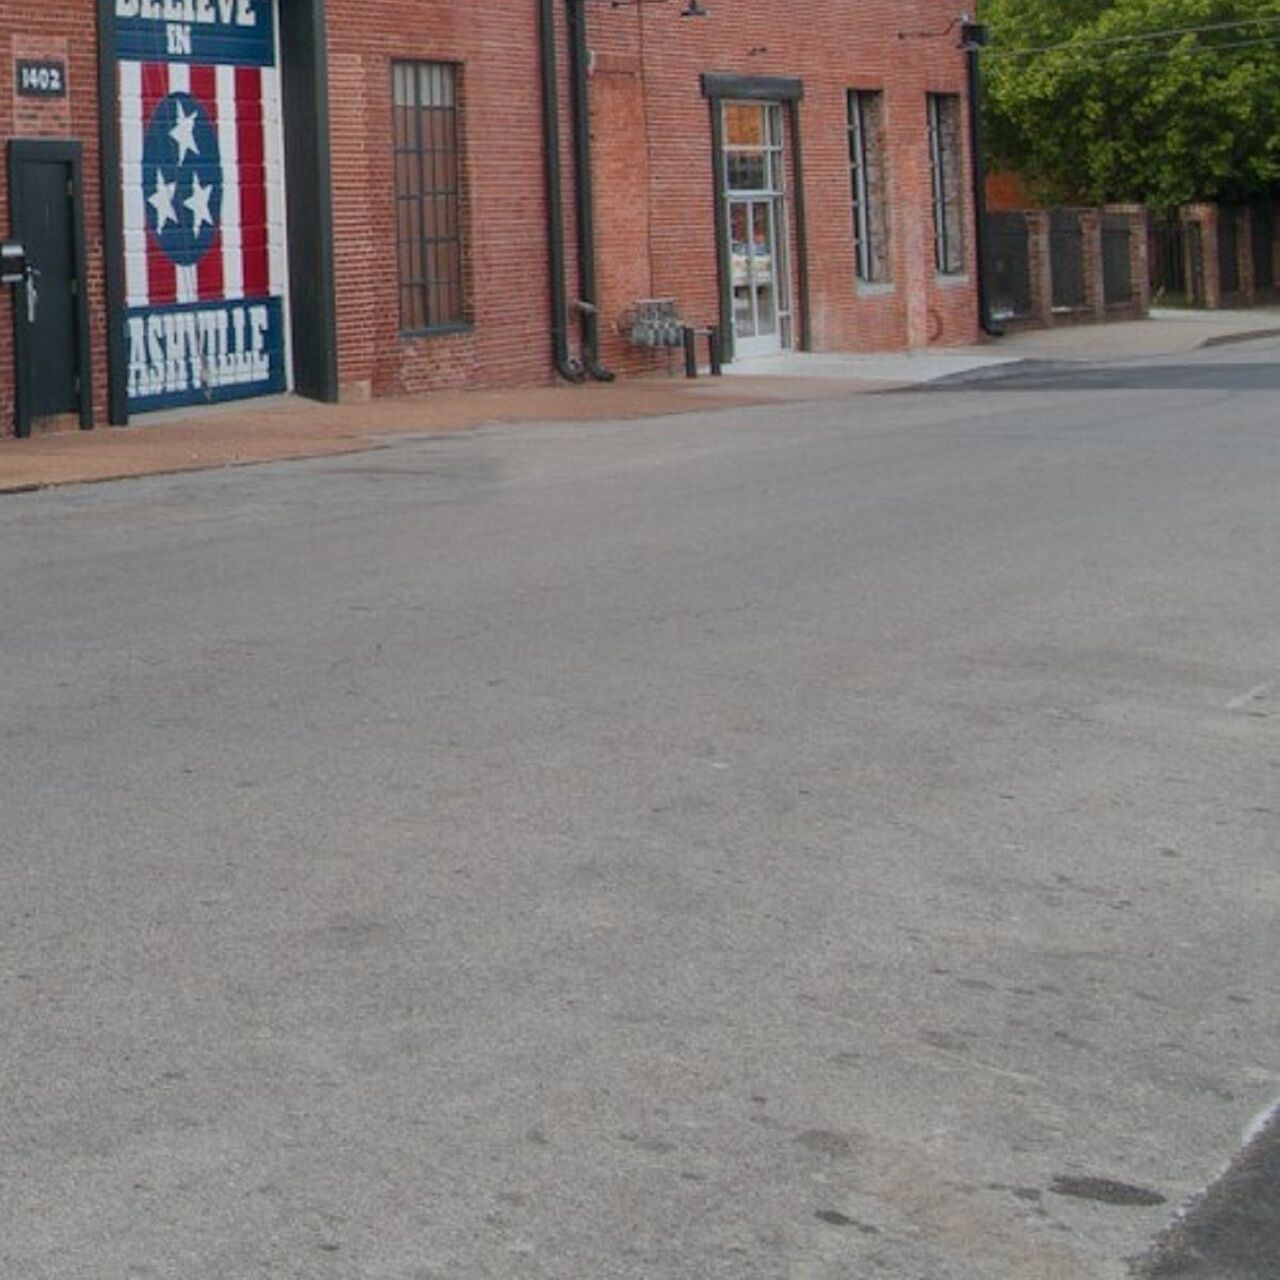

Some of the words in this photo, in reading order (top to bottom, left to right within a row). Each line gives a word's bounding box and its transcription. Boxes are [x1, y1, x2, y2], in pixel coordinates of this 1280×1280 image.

[166, 24, 191, 54] IN
[22, 68, 61, 90] 1402
[124, 305, 270, 397] ASHVILLE
